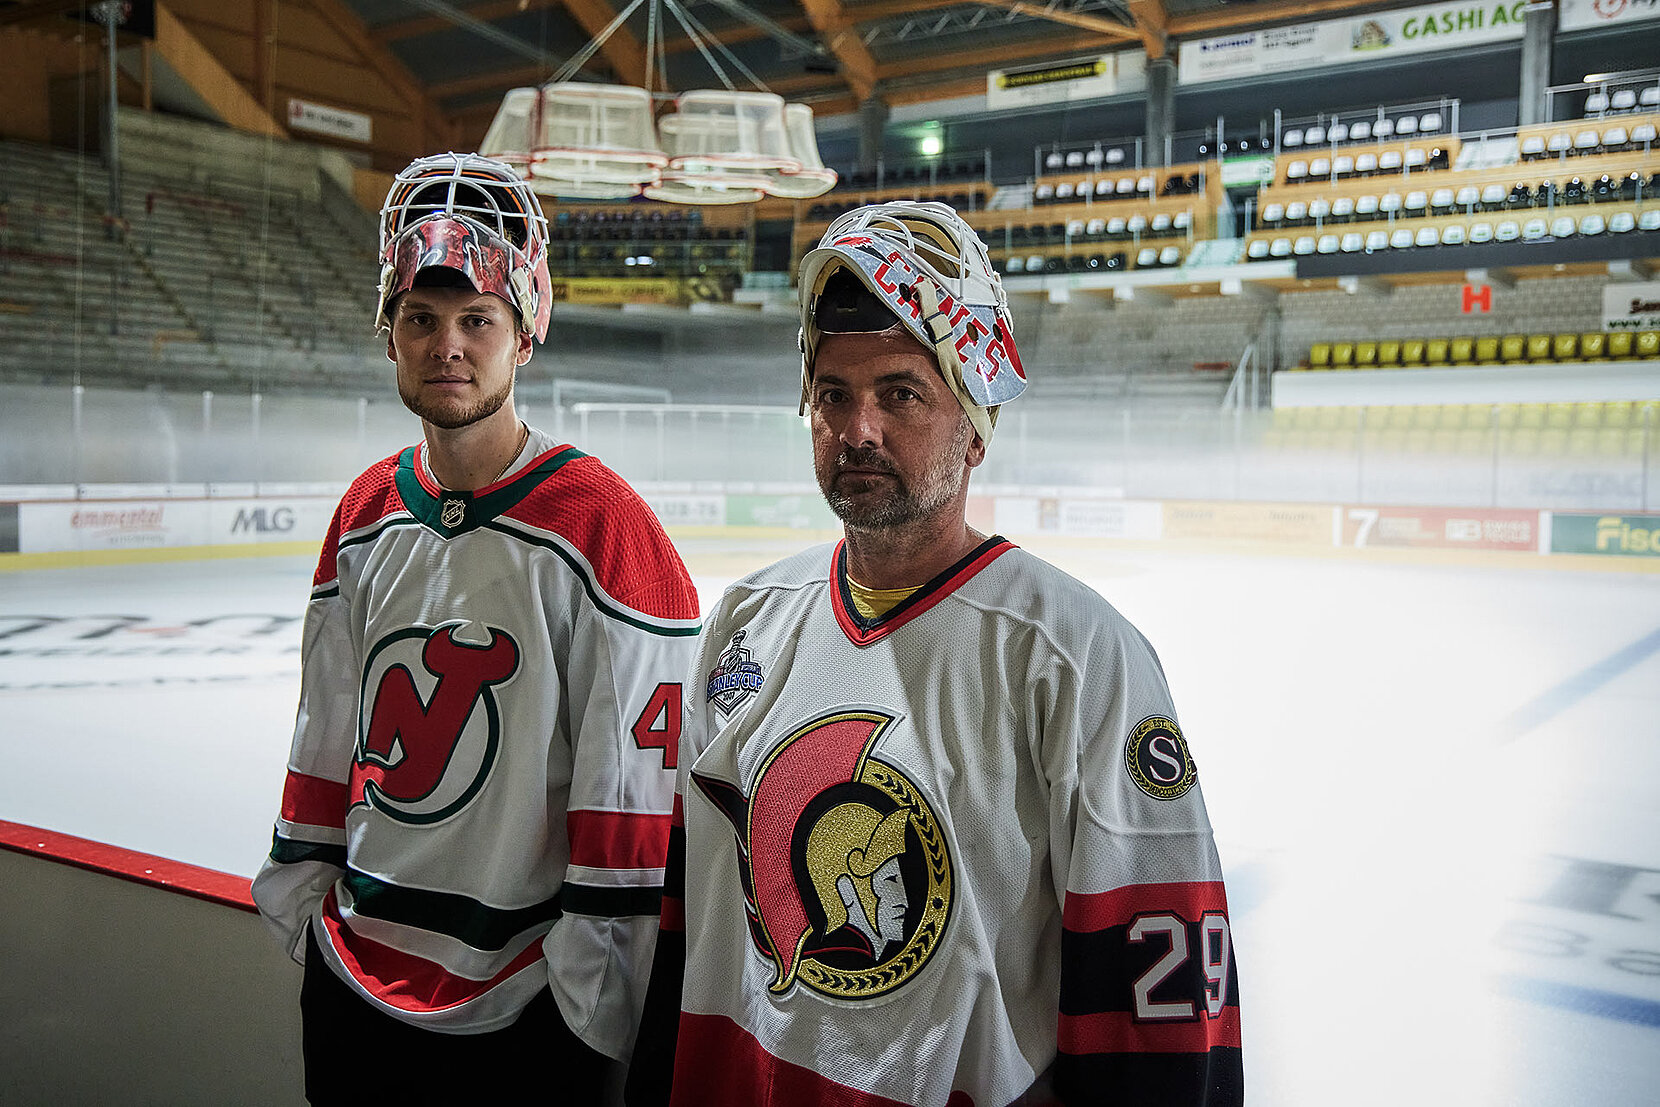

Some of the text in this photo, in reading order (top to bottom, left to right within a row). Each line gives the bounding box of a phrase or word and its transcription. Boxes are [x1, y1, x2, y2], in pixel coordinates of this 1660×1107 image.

[1402, 1, 1526, 40] GASHI AG
[1461, 284, 1492, 314] H
[1347, 508, 1379, 548] 7
[707, 673, 741, 699] STANLEY
[741, 672, 764, 690] CUP
[631, 682, 683, 769] 4
[1149, 735, 1182, 782] S
[1127, 910, 1230, 1022] 29
